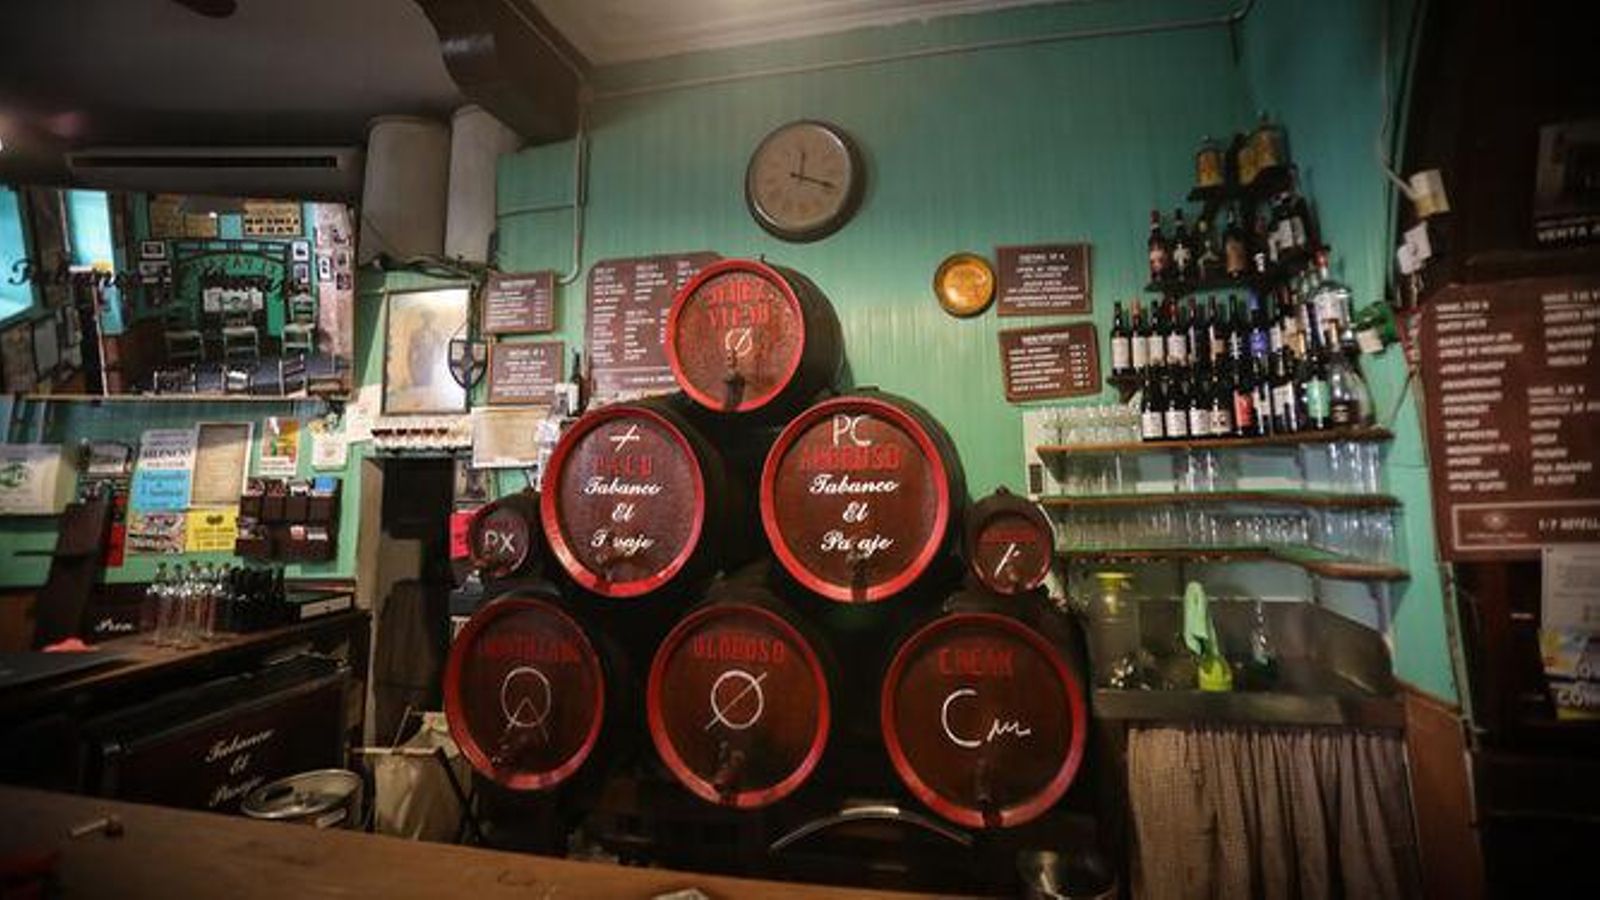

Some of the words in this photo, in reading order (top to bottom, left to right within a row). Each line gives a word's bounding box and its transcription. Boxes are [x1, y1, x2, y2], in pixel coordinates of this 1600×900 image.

[832, 415, 872, 447] PC
[584, 476, 663, 495] Tabanco
[809, 473, 899, 495] Tabanco
[611, 503, 635, 523] El
[842, 502, 869, 523] El
[484, 530, 516, 553] PX
